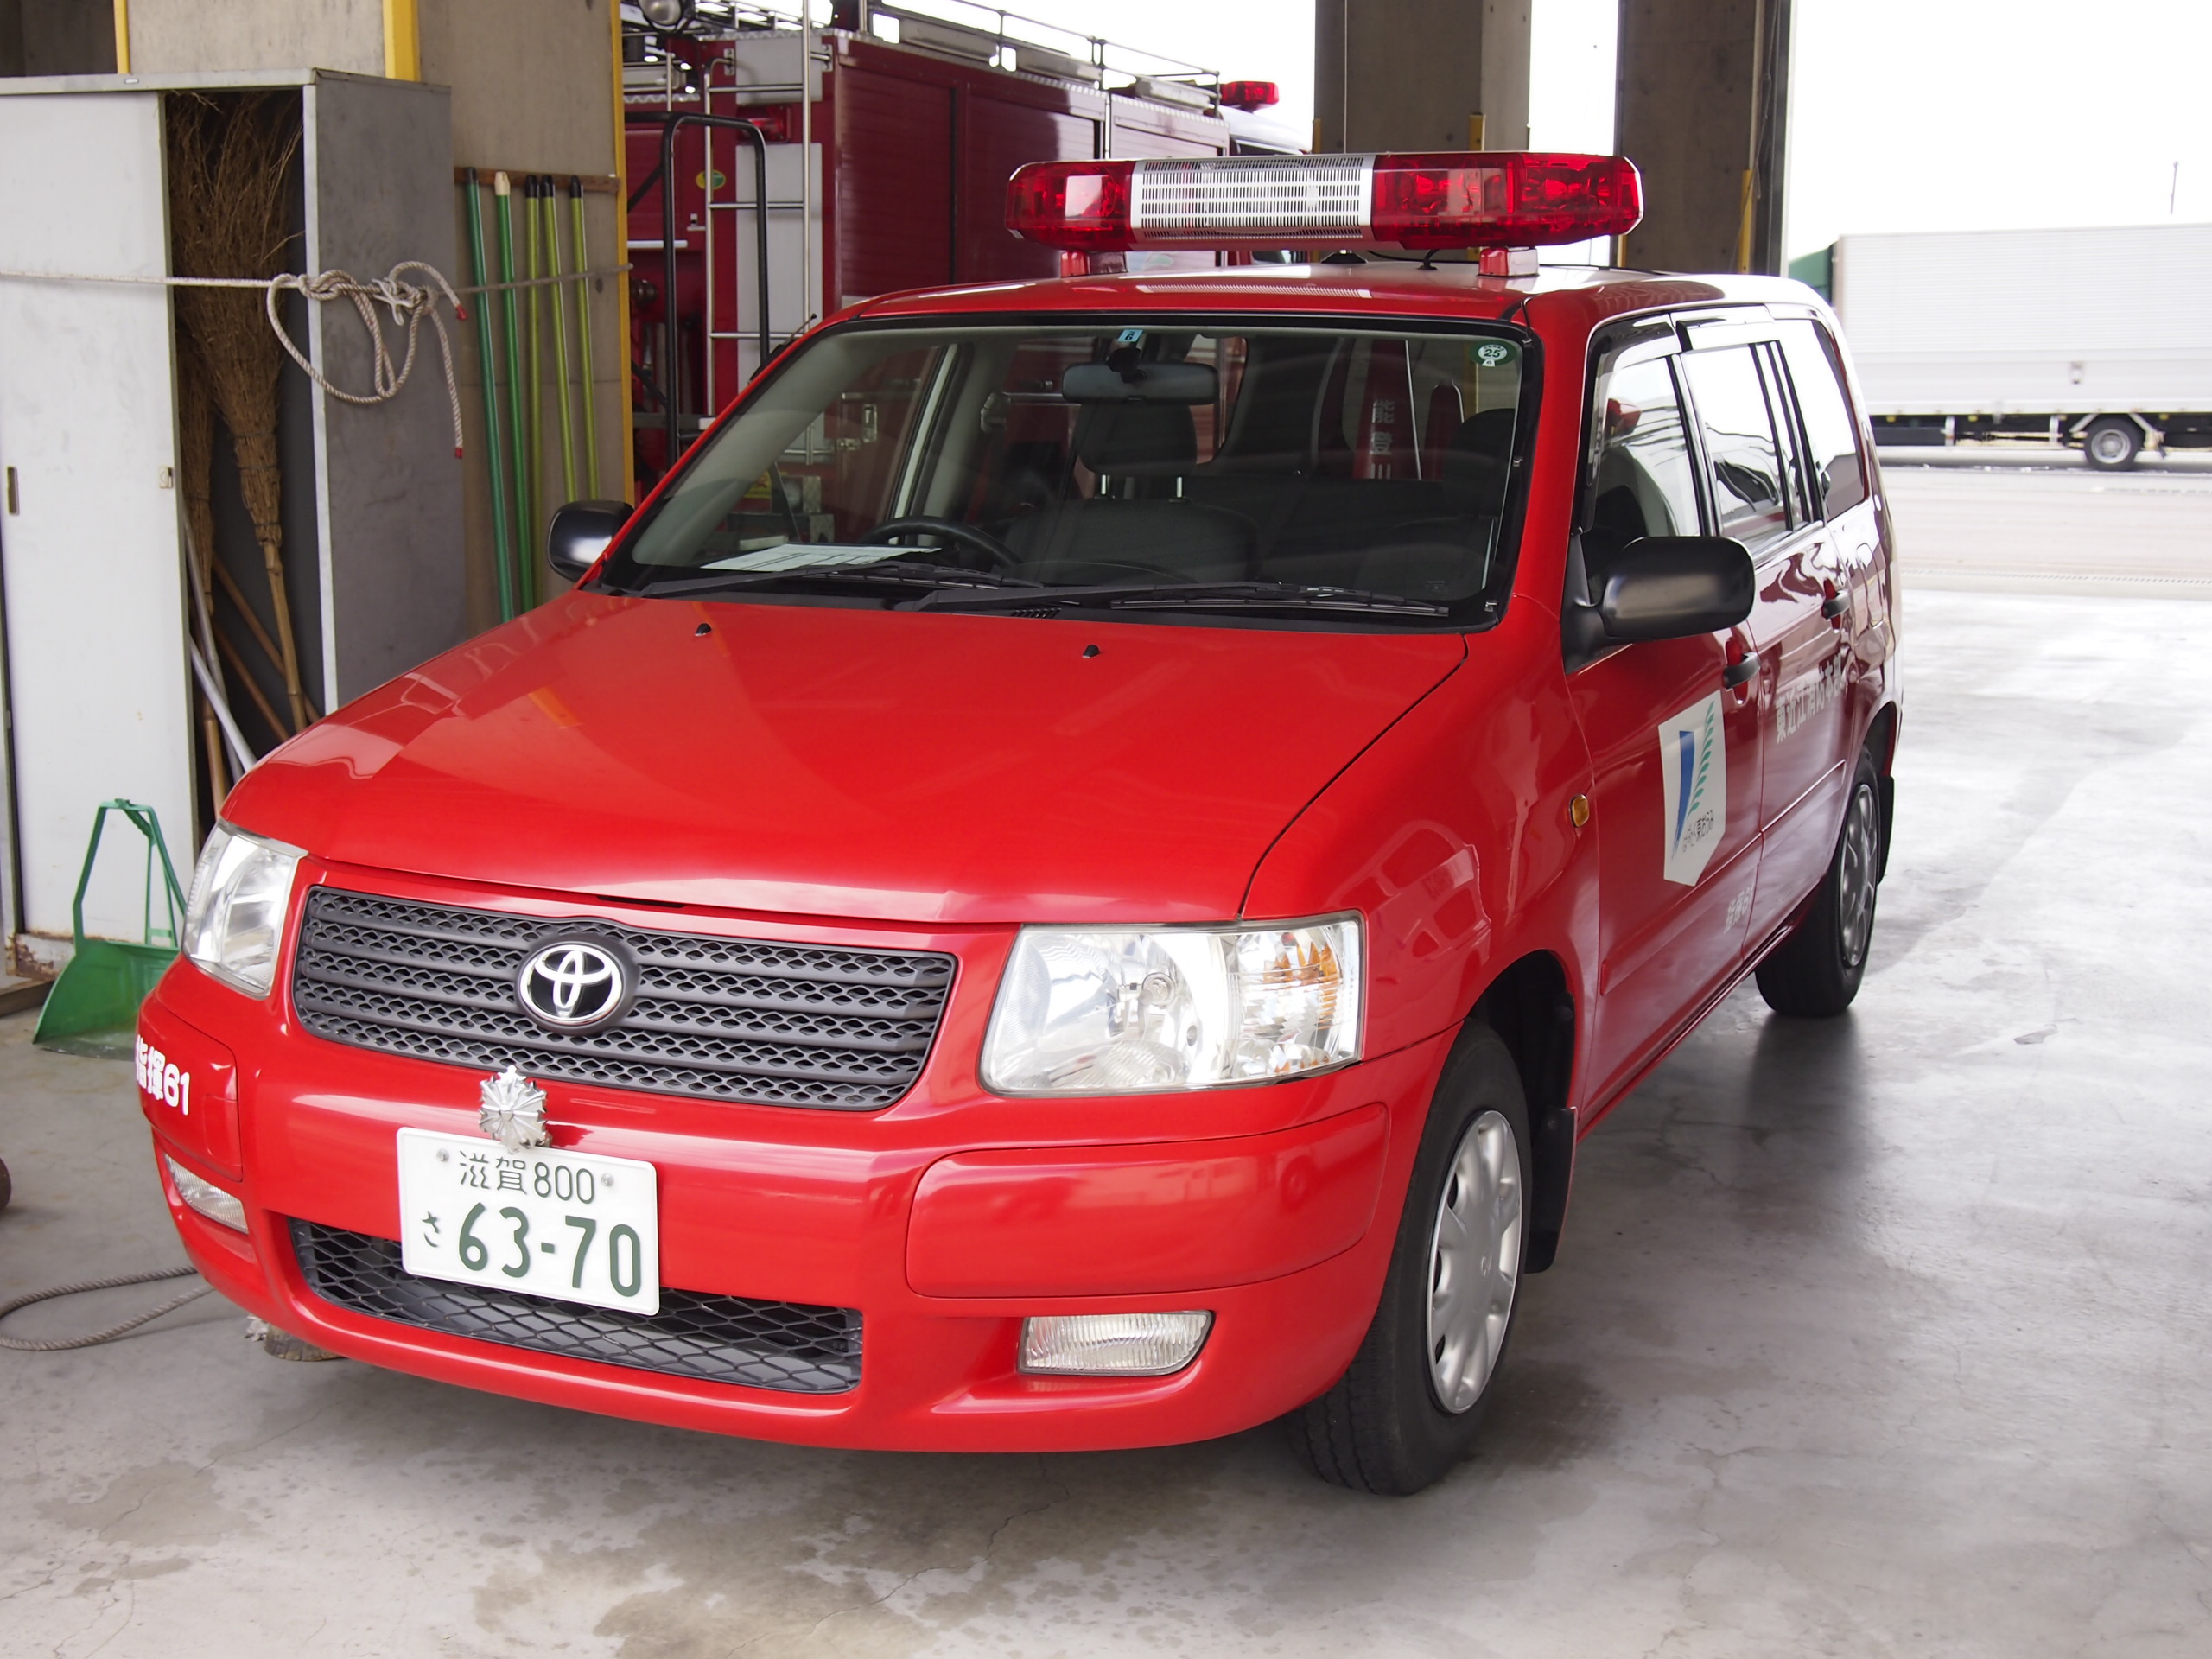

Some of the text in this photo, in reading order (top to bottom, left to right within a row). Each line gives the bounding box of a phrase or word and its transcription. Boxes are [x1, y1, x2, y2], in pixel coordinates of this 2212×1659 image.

[1484, 348, 1502, 358] 25
[421, 1201, 642, 1298] さ 63-70
